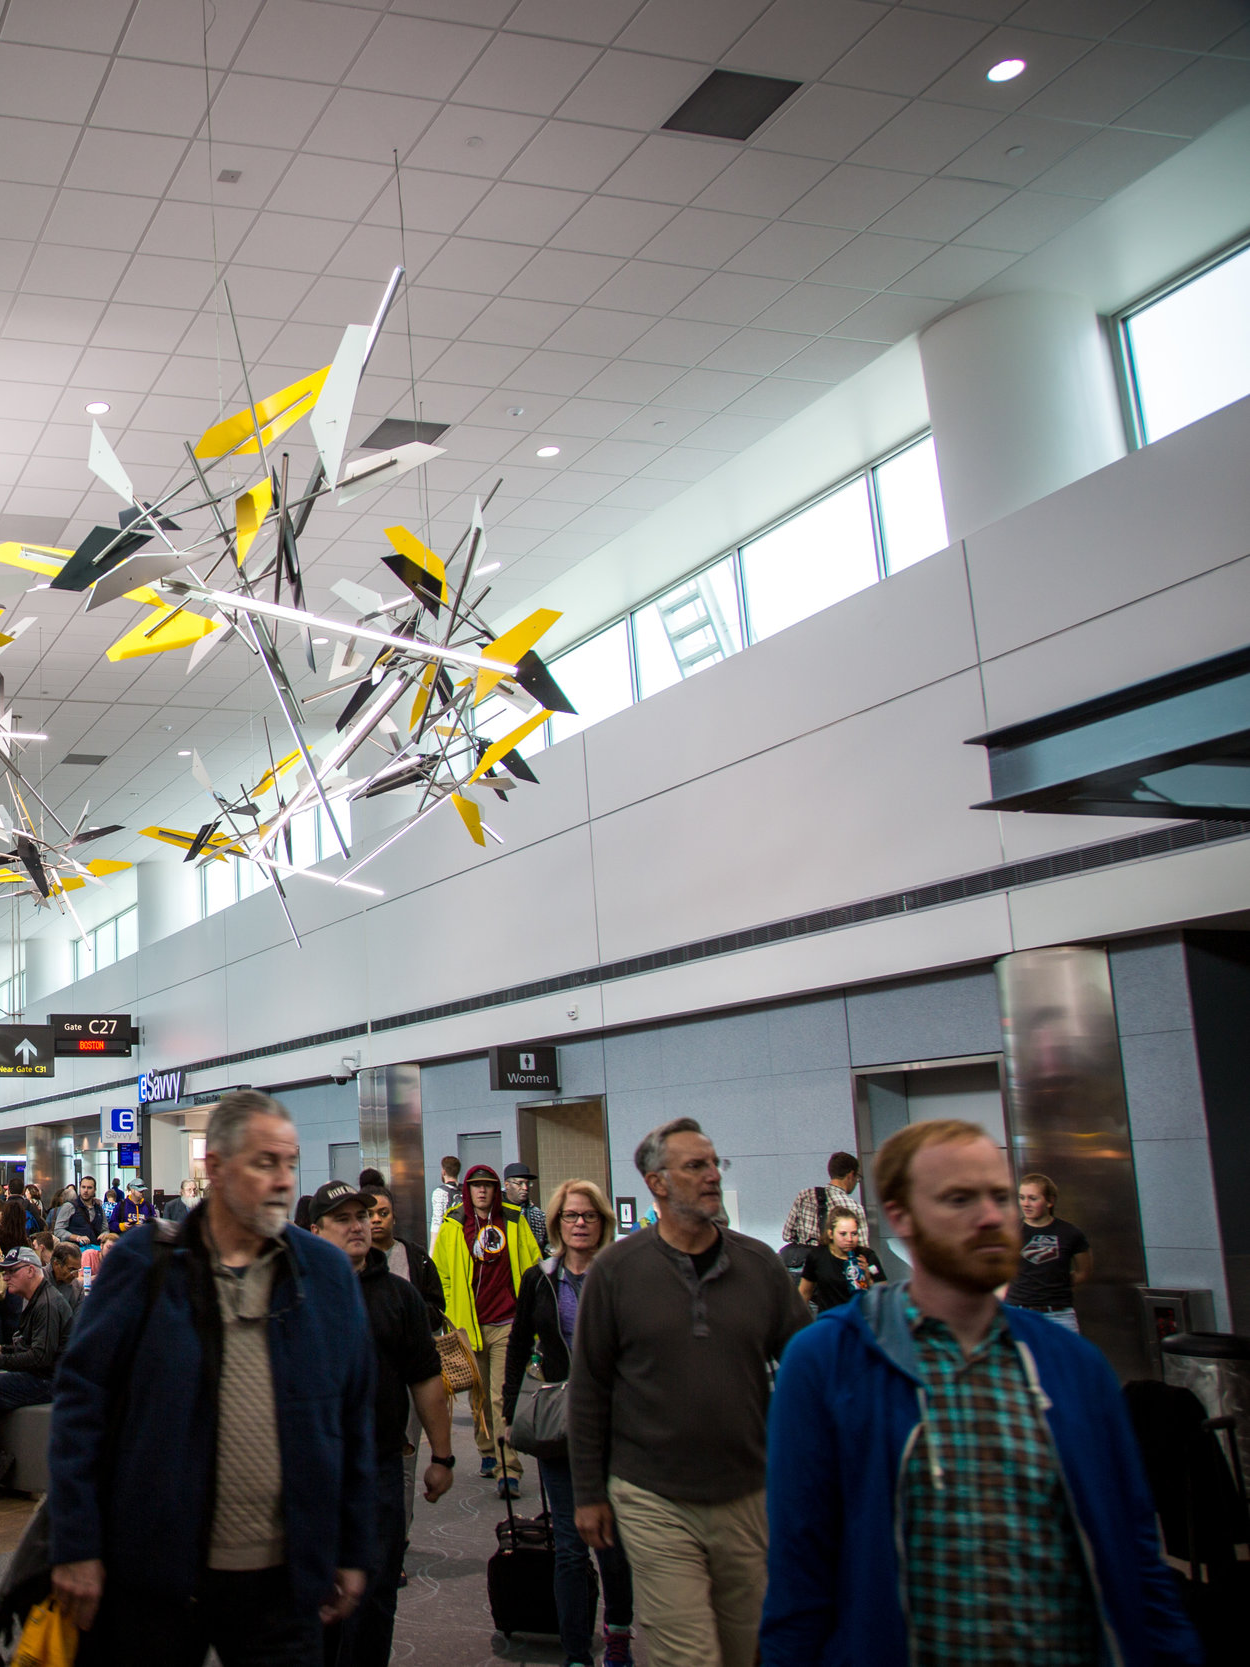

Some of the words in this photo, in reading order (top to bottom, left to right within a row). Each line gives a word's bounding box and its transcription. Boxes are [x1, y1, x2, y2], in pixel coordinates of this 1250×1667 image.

[64, 1023, 83, 1031] Gate
[88, 1019, 118, 1035] C27
[78, 1040, 105, 1051] BOSTON
[507, 1073, 550, 1084] Women
[105, 1130, 134, 1140] Savvy
